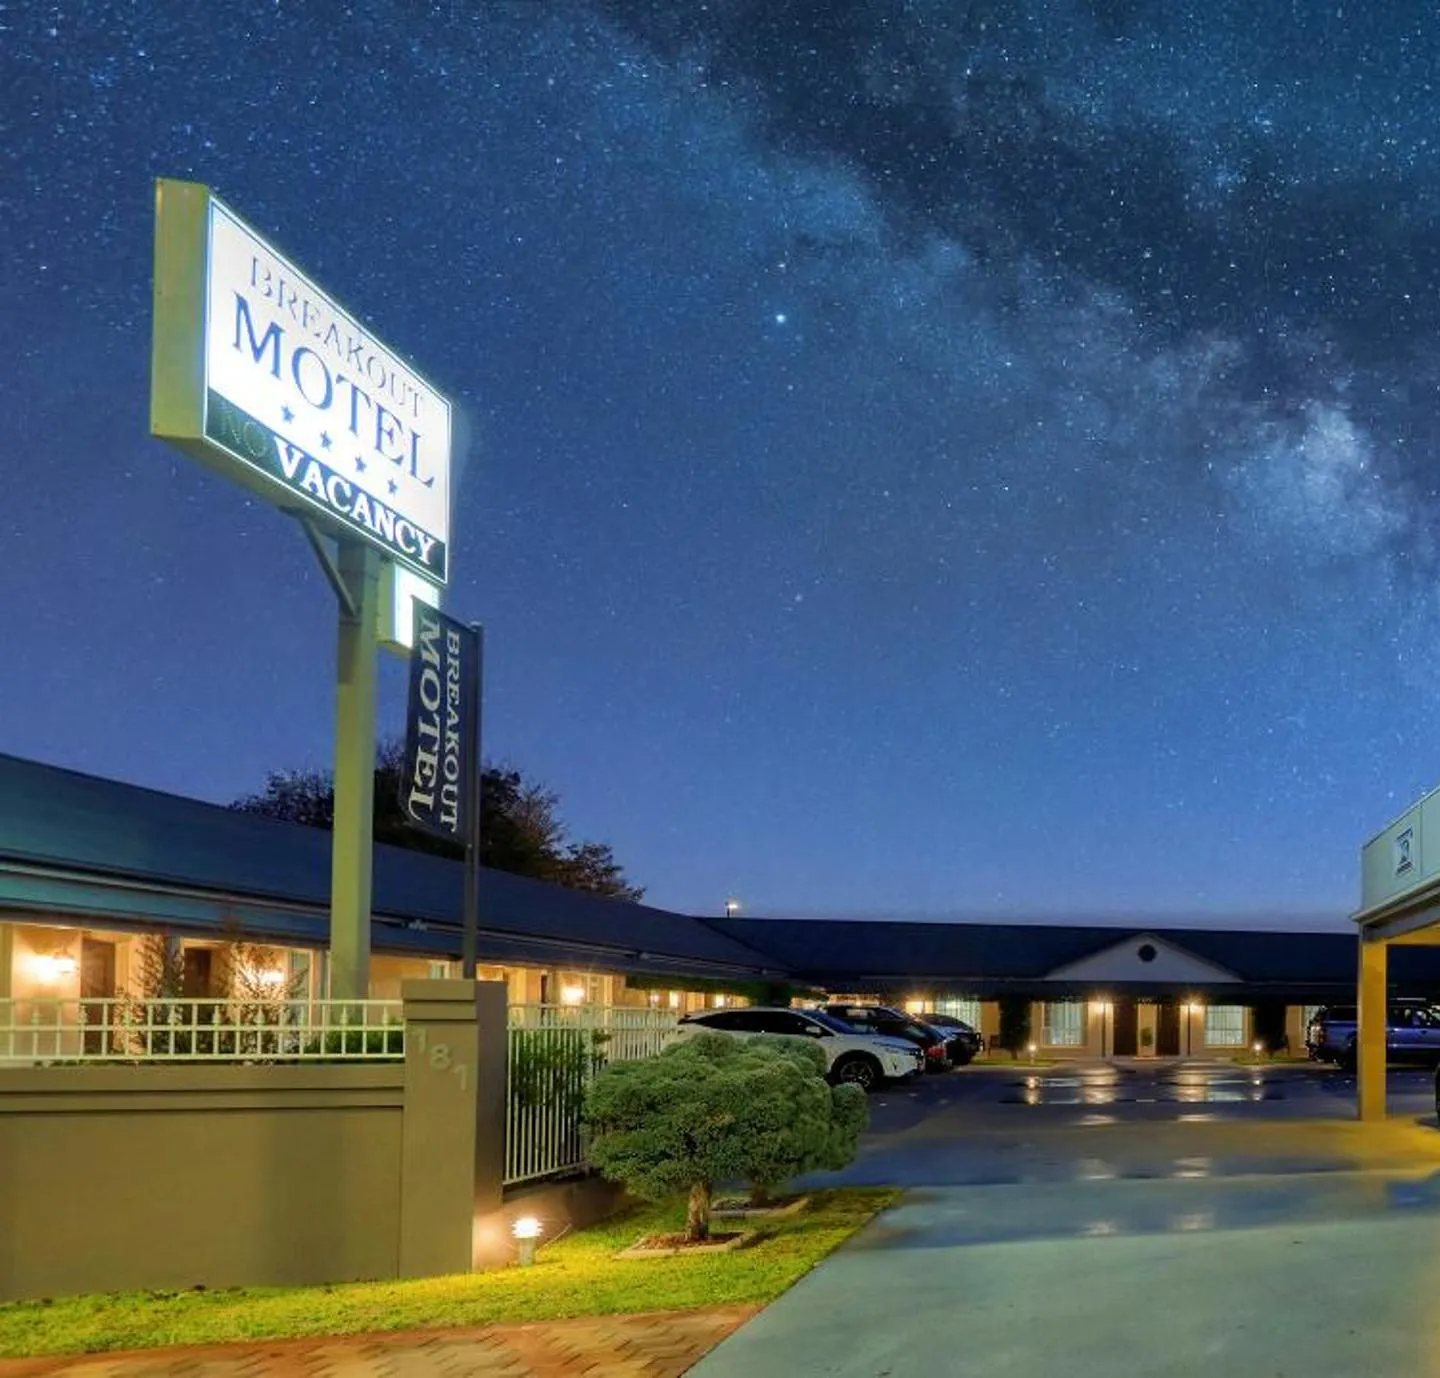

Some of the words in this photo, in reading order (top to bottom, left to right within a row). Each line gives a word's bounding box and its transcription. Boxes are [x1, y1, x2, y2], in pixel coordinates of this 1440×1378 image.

[232, 290, 435, 488] MOTEL
[251, 255, 423, 418] BREAKOUT
[218, 398, 268, 458] NO
[273, 435, 436, 566] VACANCY
[408, 615, 441, 822] MOTEL
[440, 630, 460, 833] BREAKOUT
[411, 1024, 468, 1092] 181
